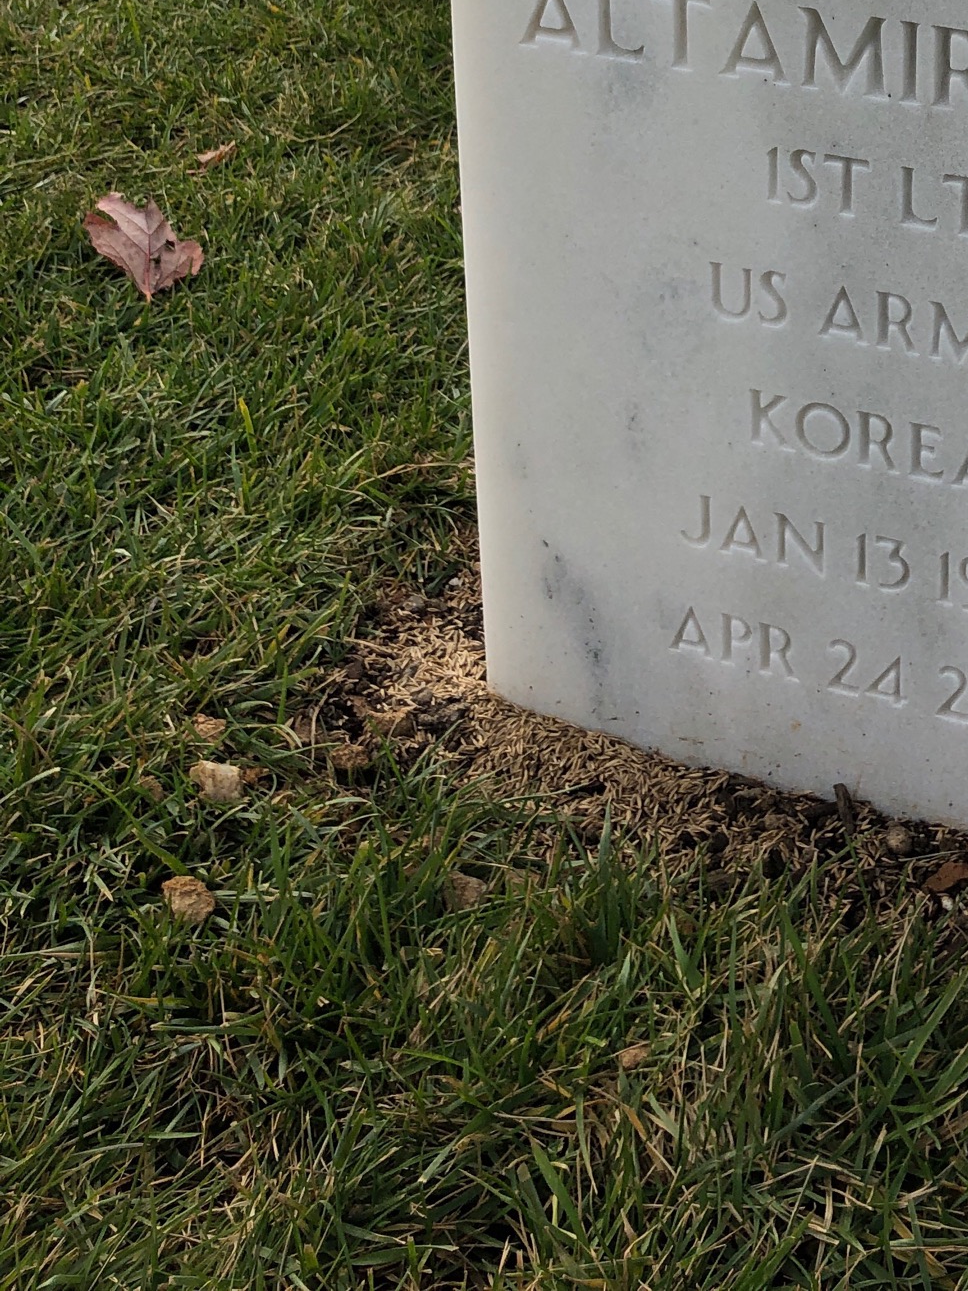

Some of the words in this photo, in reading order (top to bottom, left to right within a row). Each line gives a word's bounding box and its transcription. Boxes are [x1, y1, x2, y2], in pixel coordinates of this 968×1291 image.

[766, 146, 871, 217] 1ST
[709, 261, 788, 328] US
[680, 494, 827, 578] JAN
[854, 532, 910, 593] 13
[668, 605, 800, 682] APR
[826, 638, 908, 708] 24
